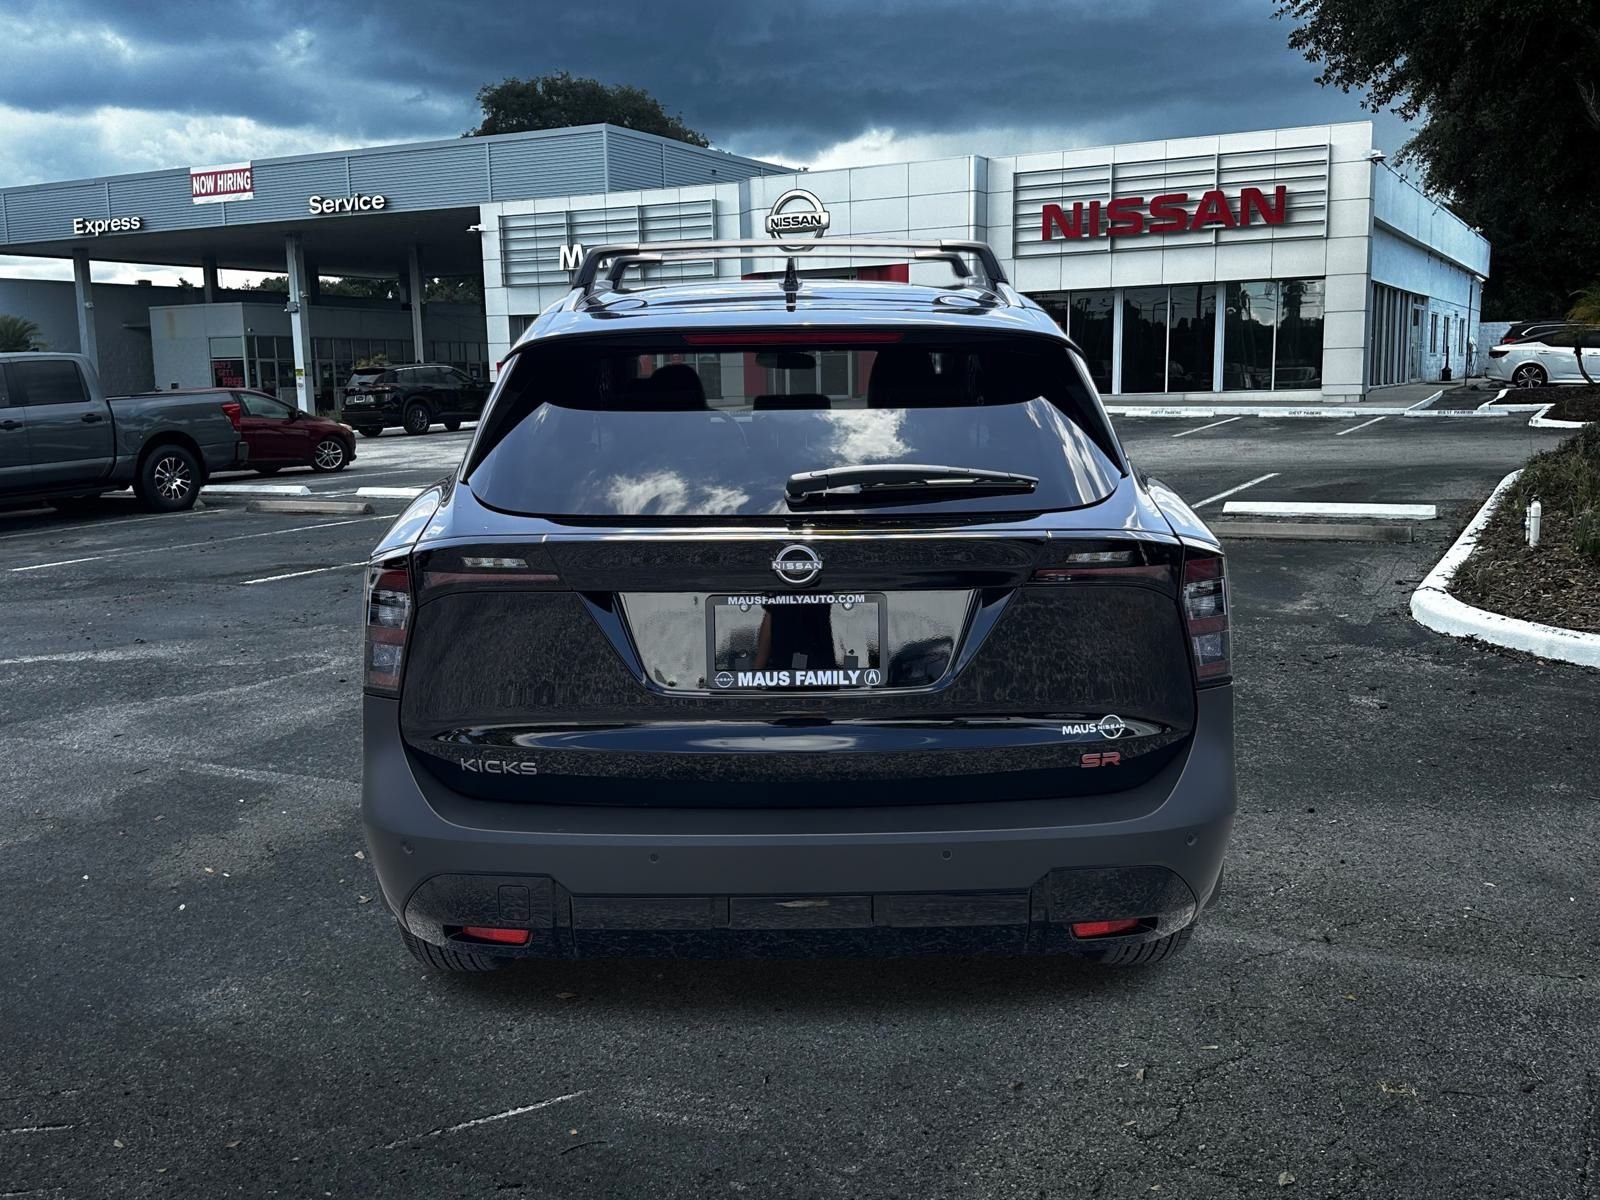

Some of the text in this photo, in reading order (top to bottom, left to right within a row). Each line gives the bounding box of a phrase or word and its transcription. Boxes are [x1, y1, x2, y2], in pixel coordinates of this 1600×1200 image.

[192, 171, 251, 195] NOW HIRING
[309, 193, 385, 214] Service
[770, 214, 822, 228] NISSAN
[1041, 185, 1287, 241] NISSAN
[73, 216, 141, 236] Express
[772, 561, 822, 570] NISSAN
[727, 594, 865, 605] MAUSFAMILYAUTO.COM
[738, 670, 860, 687] MAUS FAMILY
[1062, 724, 1097, 735] MAUS
[460, 757, 537, 775] KICKS
[1081, 751, 1120, 768] SR
